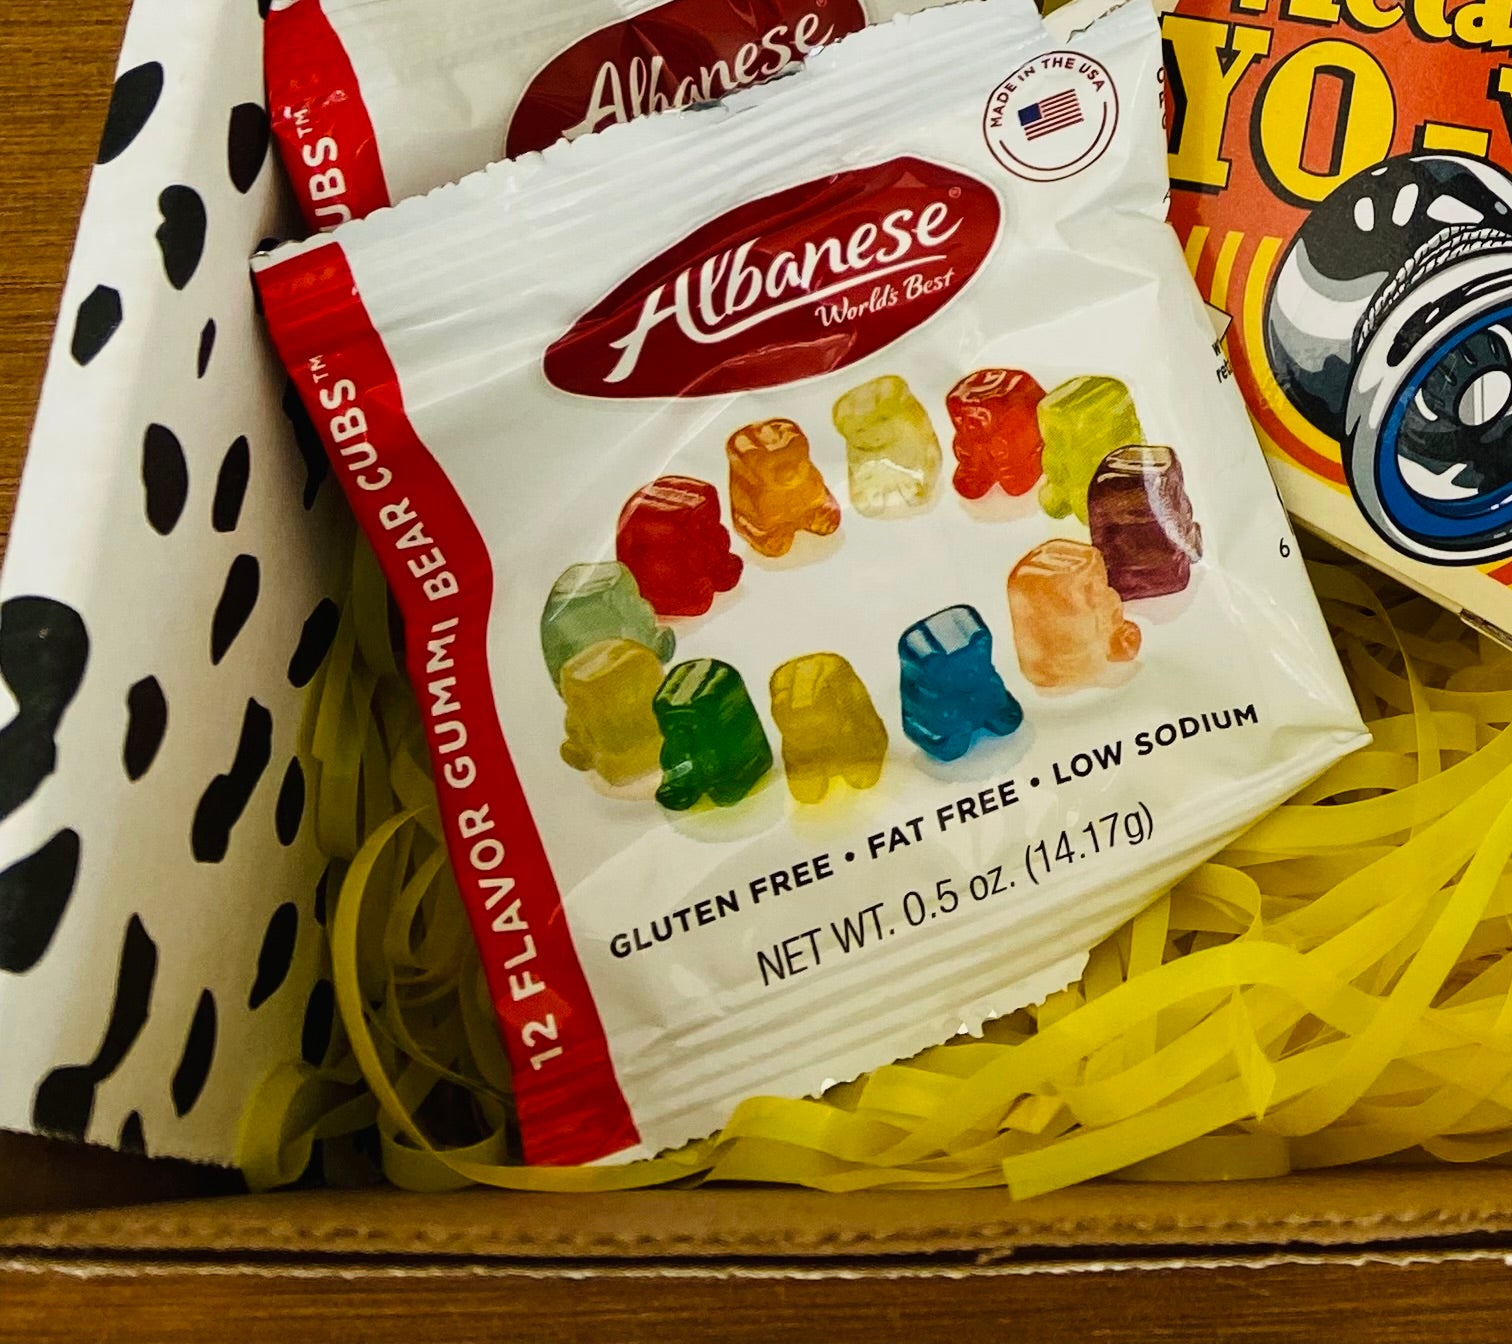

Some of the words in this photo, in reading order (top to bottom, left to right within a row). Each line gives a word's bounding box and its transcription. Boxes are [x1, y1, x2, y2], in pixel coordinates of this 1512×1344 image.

[990, 82, 1018, 128] MADE
[1017, 66, 1036, 82] IN
[1041, 57, 1076, 69] THE
[1078, 63, 1105, 93] USA
[602, 201, 964, 383] Albanese
[902, 267, 956, 300] Best
[378, 496, 460, 602] BEAR
[425, 616, 478, 789] GUMMI
[457, 802, 547, 1002] FLAVOR
[609, 889, 741, 959] GLUTEN
[749, 853, 835, 905] FREE
[867, 816, 925, 860] FAT
[936, 779, 1020, 832] FREE
[1052, 740, 1123, 785] LOW
[1134, 703, 1259, 756] SODIUM
[757, 927, 823, 987] NET
[830, 902, 896, 954] WT.
[903, 878, 959, 927] 0.5
[969, 865, 1016, 902] oz.
[1025, 801, 1155, 886] (14.17g)
[520, 1013, 563, 1071] 12
